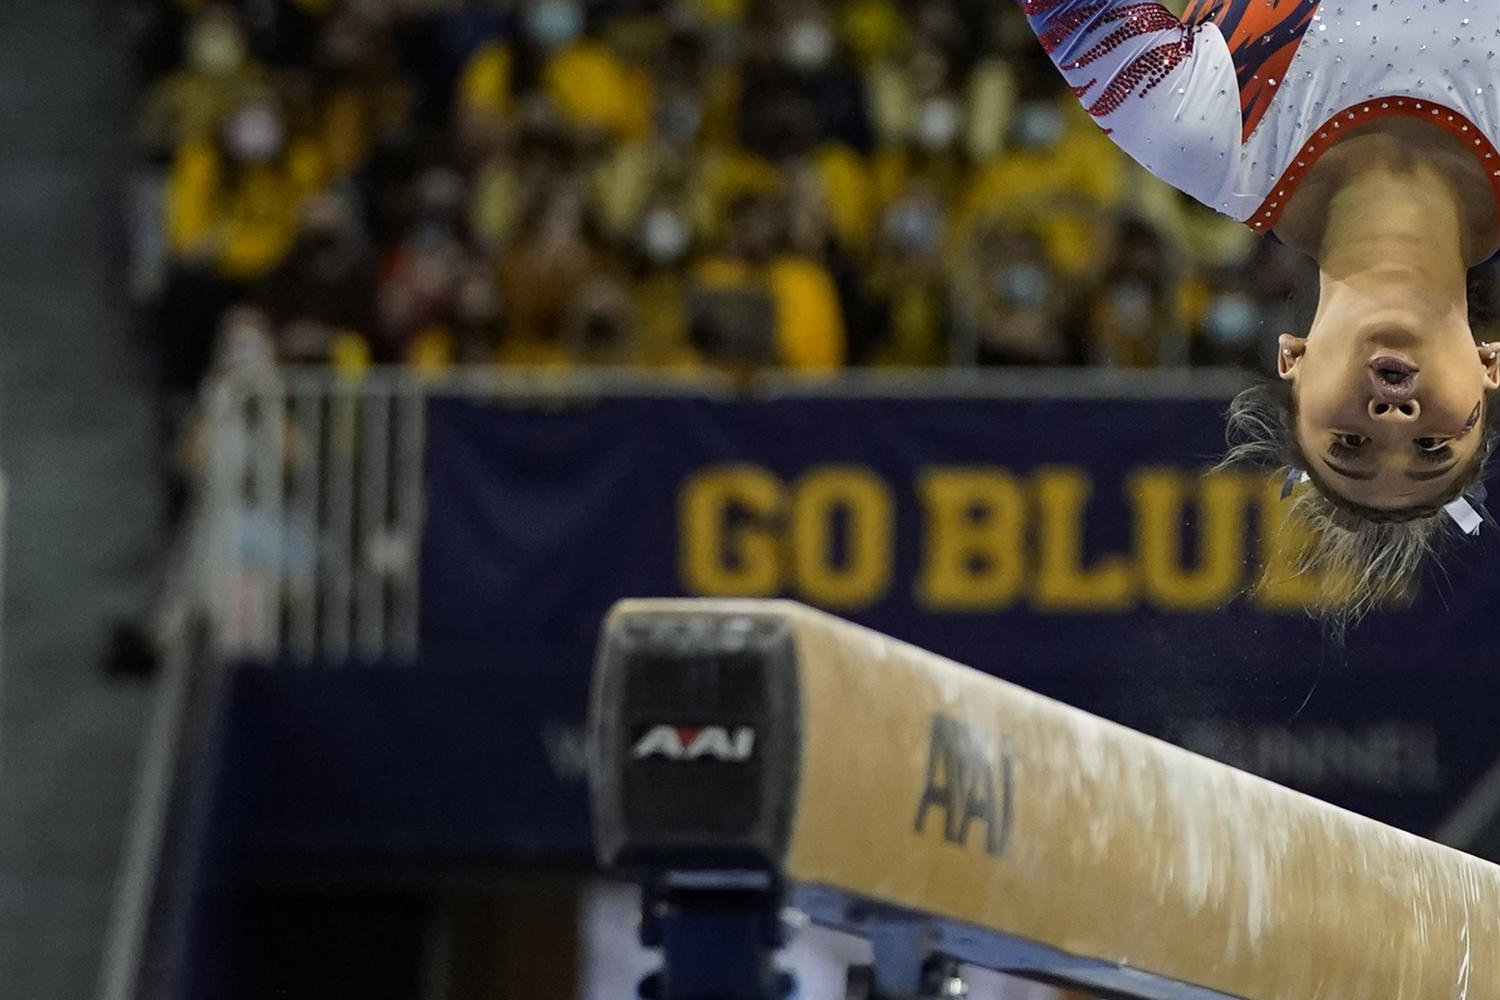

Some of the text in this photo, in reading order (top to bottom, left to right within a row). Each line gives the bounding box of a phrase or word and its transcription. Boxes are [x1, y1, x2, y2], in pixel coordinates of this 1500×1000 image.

[680, 466, 895, 608] GO
[633, 725, 756, 761] AAI
[913, 712, 1014, 857] AAI
